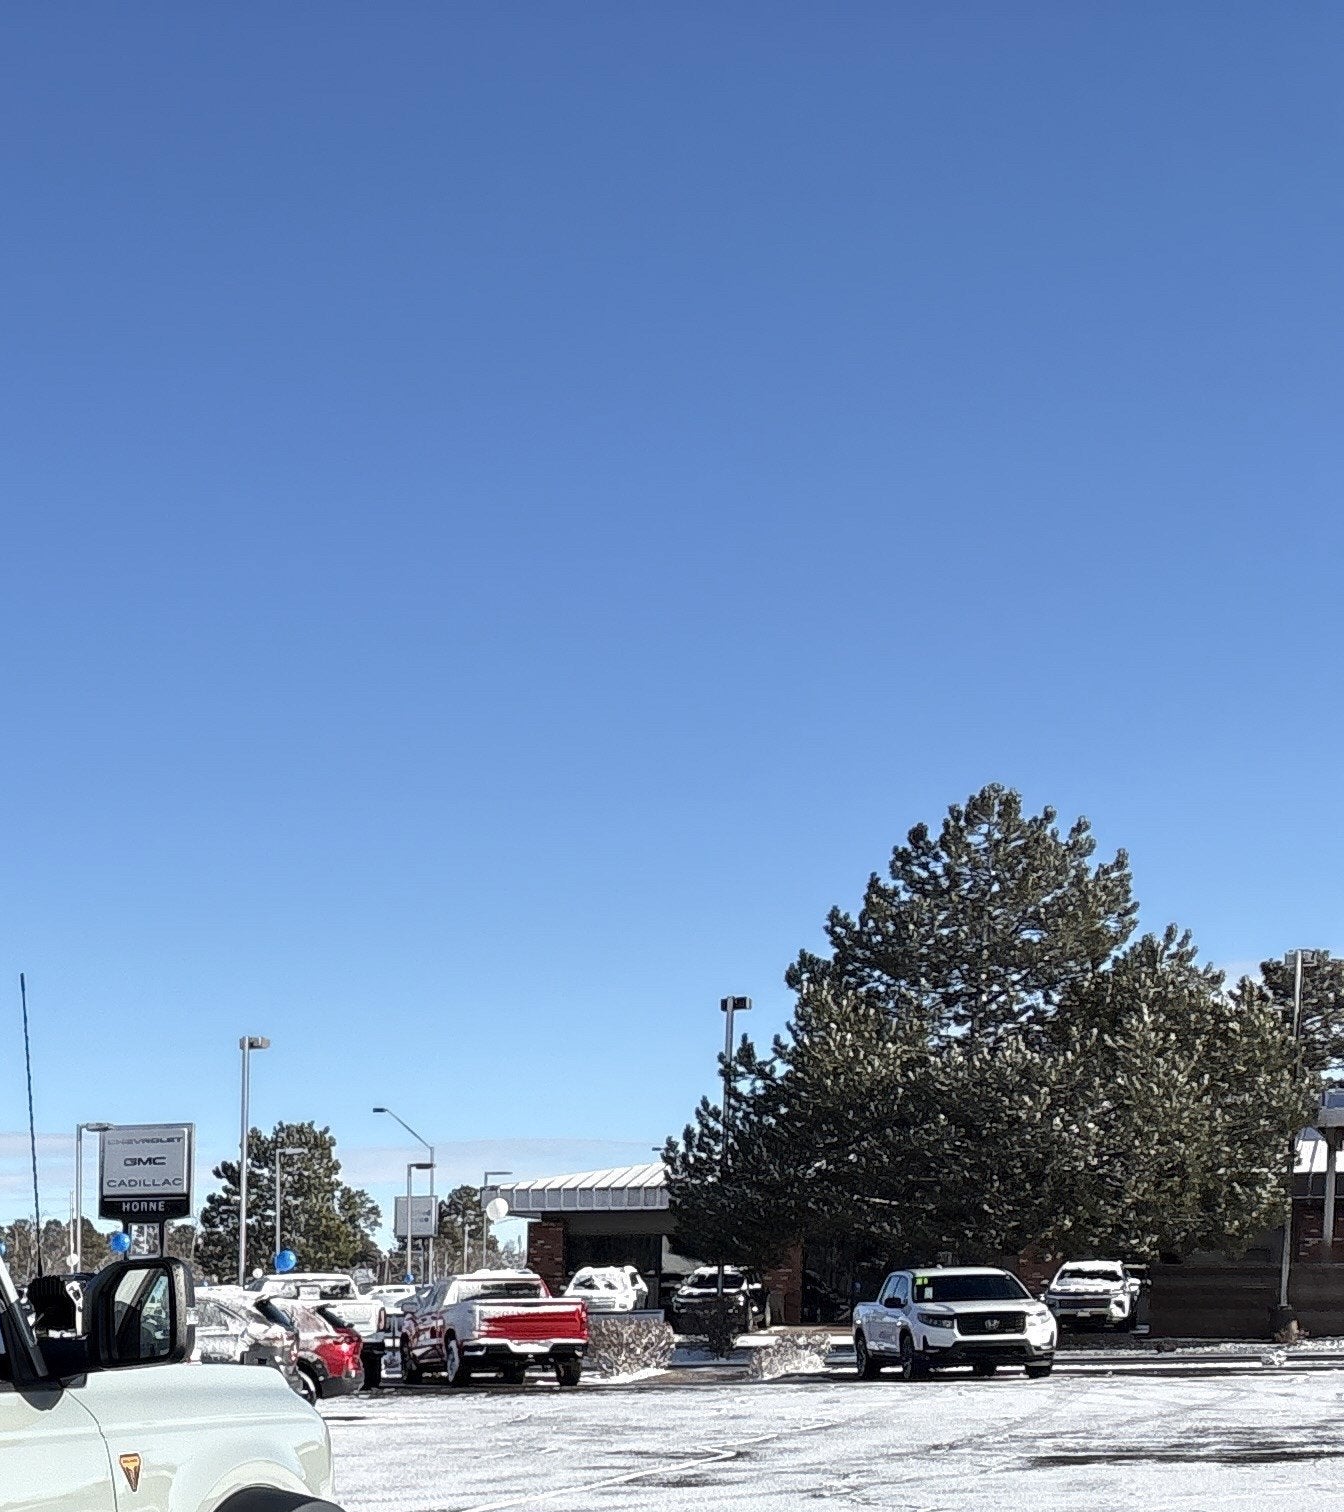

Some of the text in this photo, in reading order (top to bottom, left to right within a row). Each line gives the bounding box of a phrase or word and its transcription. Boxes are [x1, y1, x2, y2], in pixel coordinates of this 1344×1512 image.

[108, 1137, 183, 1145] CHEVROLET
[123, 1156, 167, 1167] GMC
[106, 1177, 183, 1189] CADILLAC
[122, 1200, 166, 1212] HORNE
